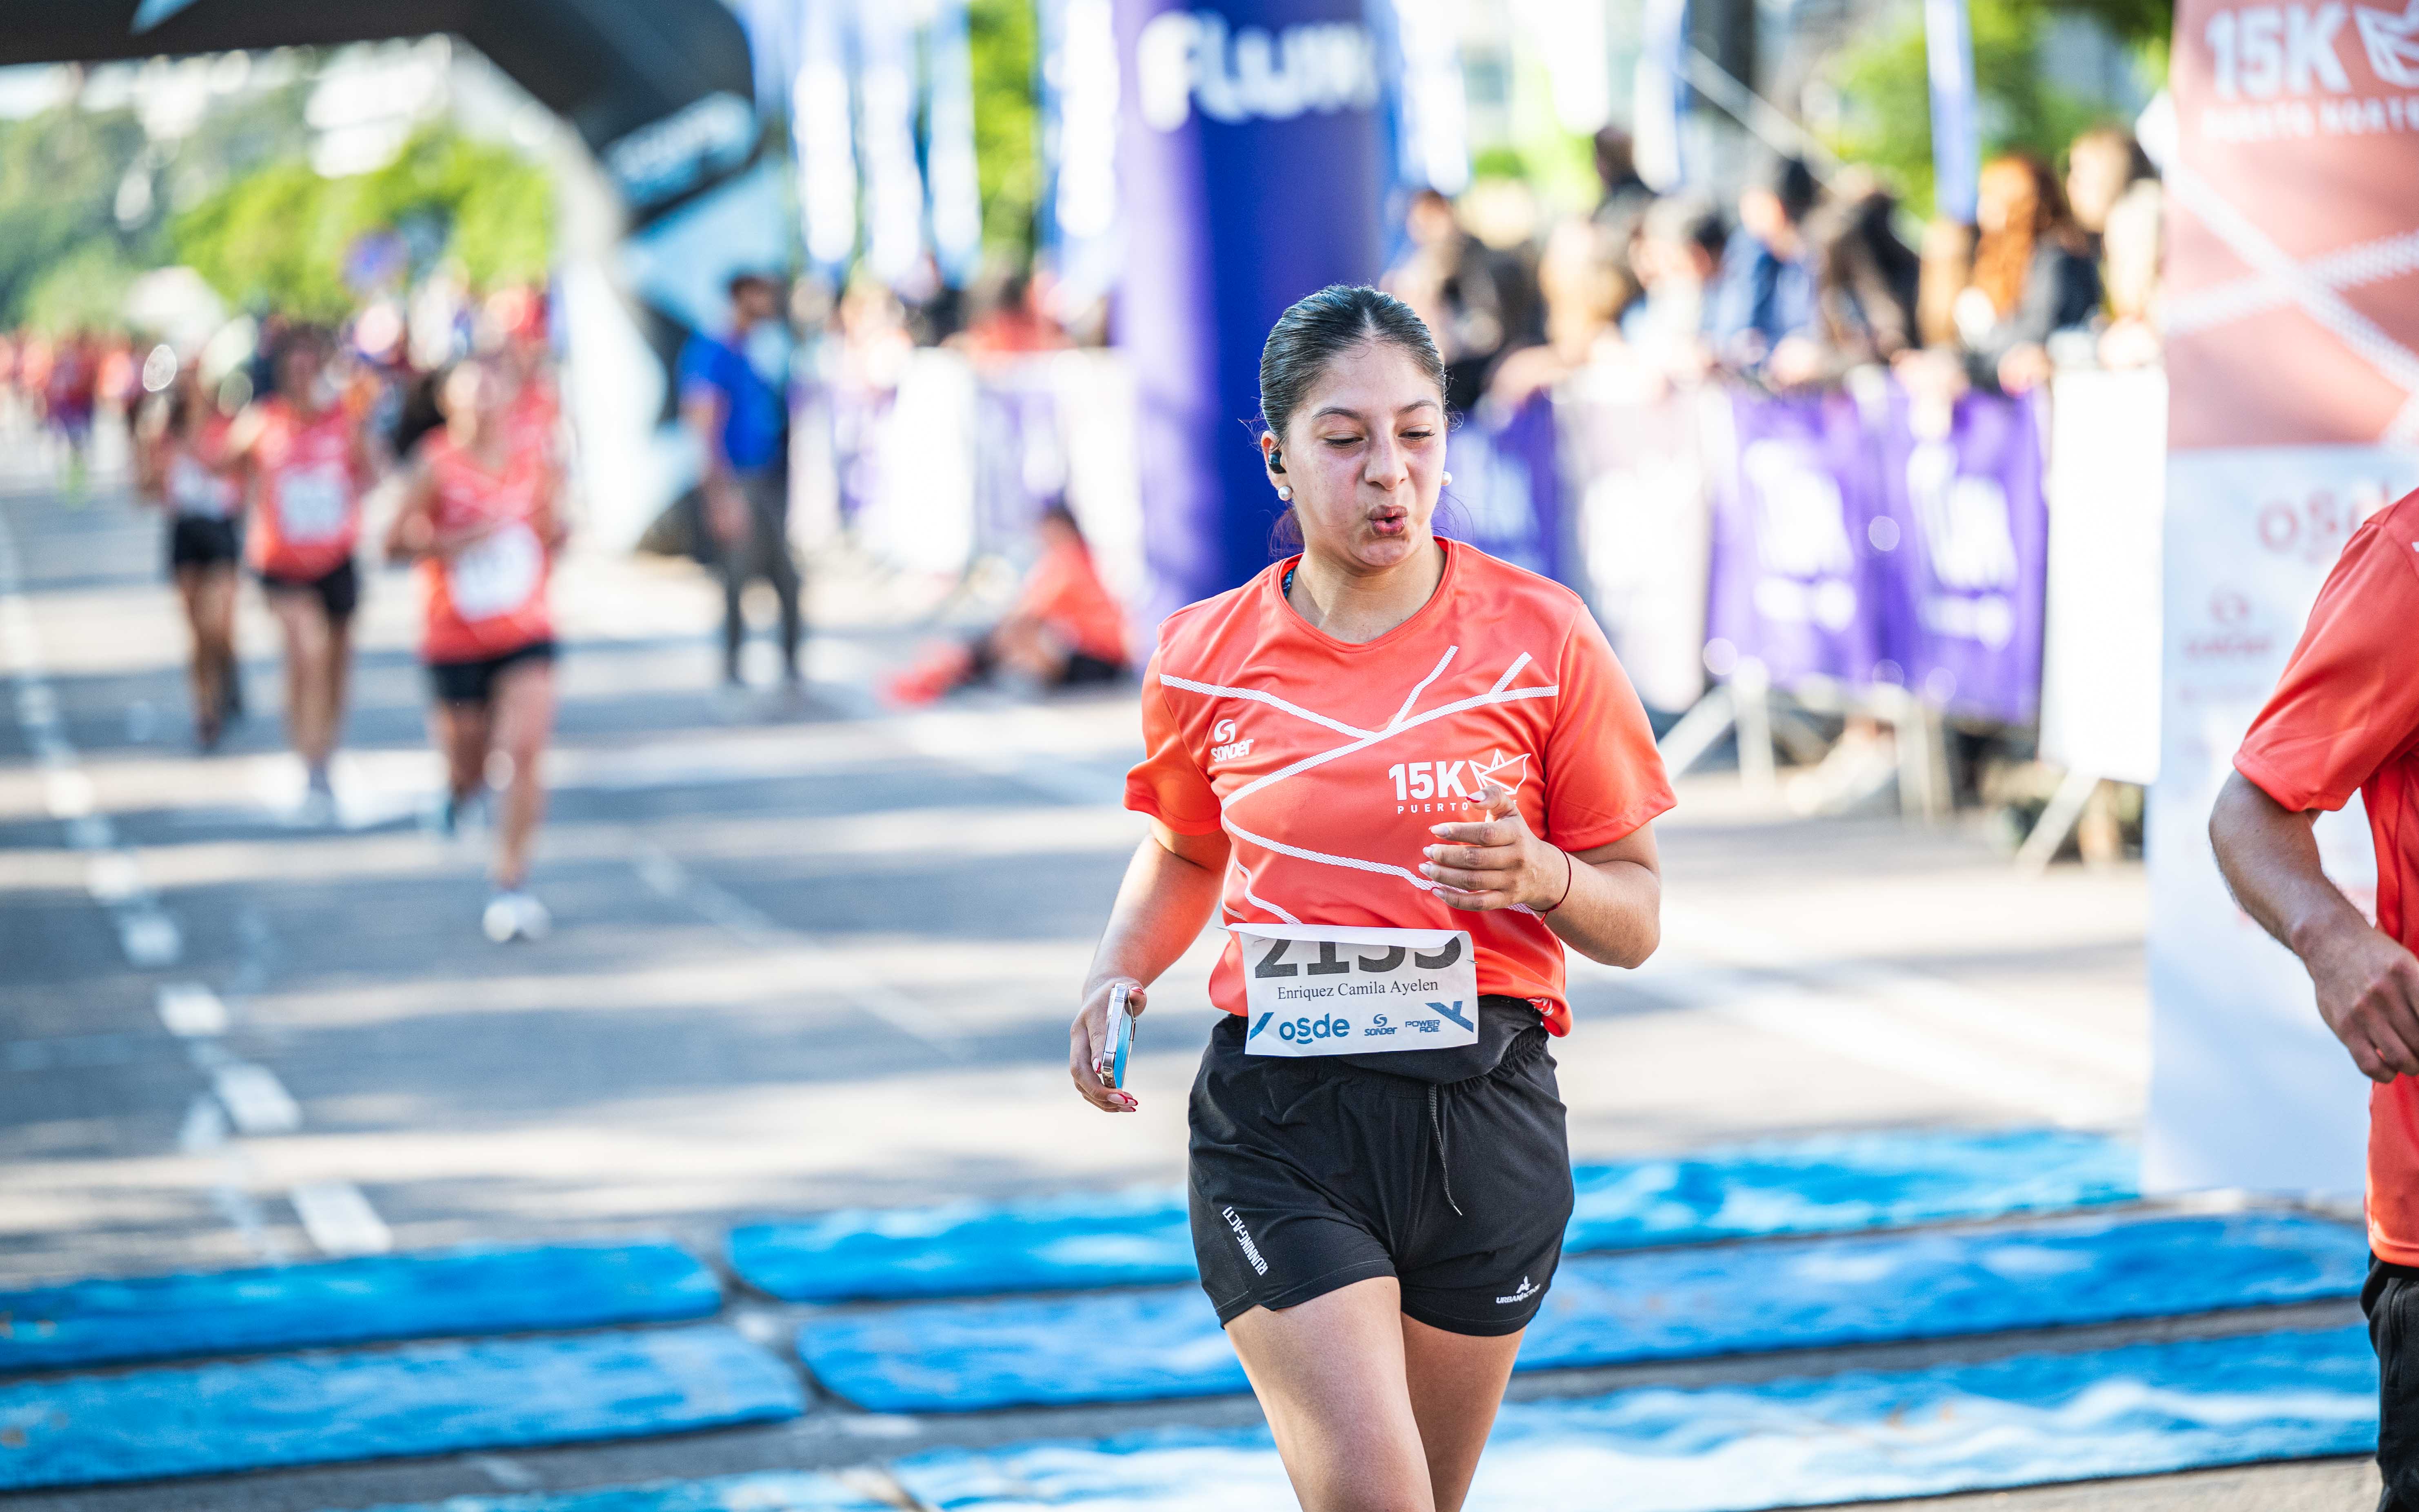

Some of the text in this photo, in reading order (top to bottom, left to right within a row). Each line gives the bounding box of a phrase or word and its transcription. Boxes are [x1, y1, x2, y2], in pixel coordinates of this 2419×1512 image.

[2205, 3, 2352, 101] 15K
[1388, 760, 1468, 801] 15K
[1397, 802, 1468, 814] PUERTO
[1277, 979, 1439, 1001] Enriquez Camila Ayelen
[1279, 1012, 1350, 1041] osde
